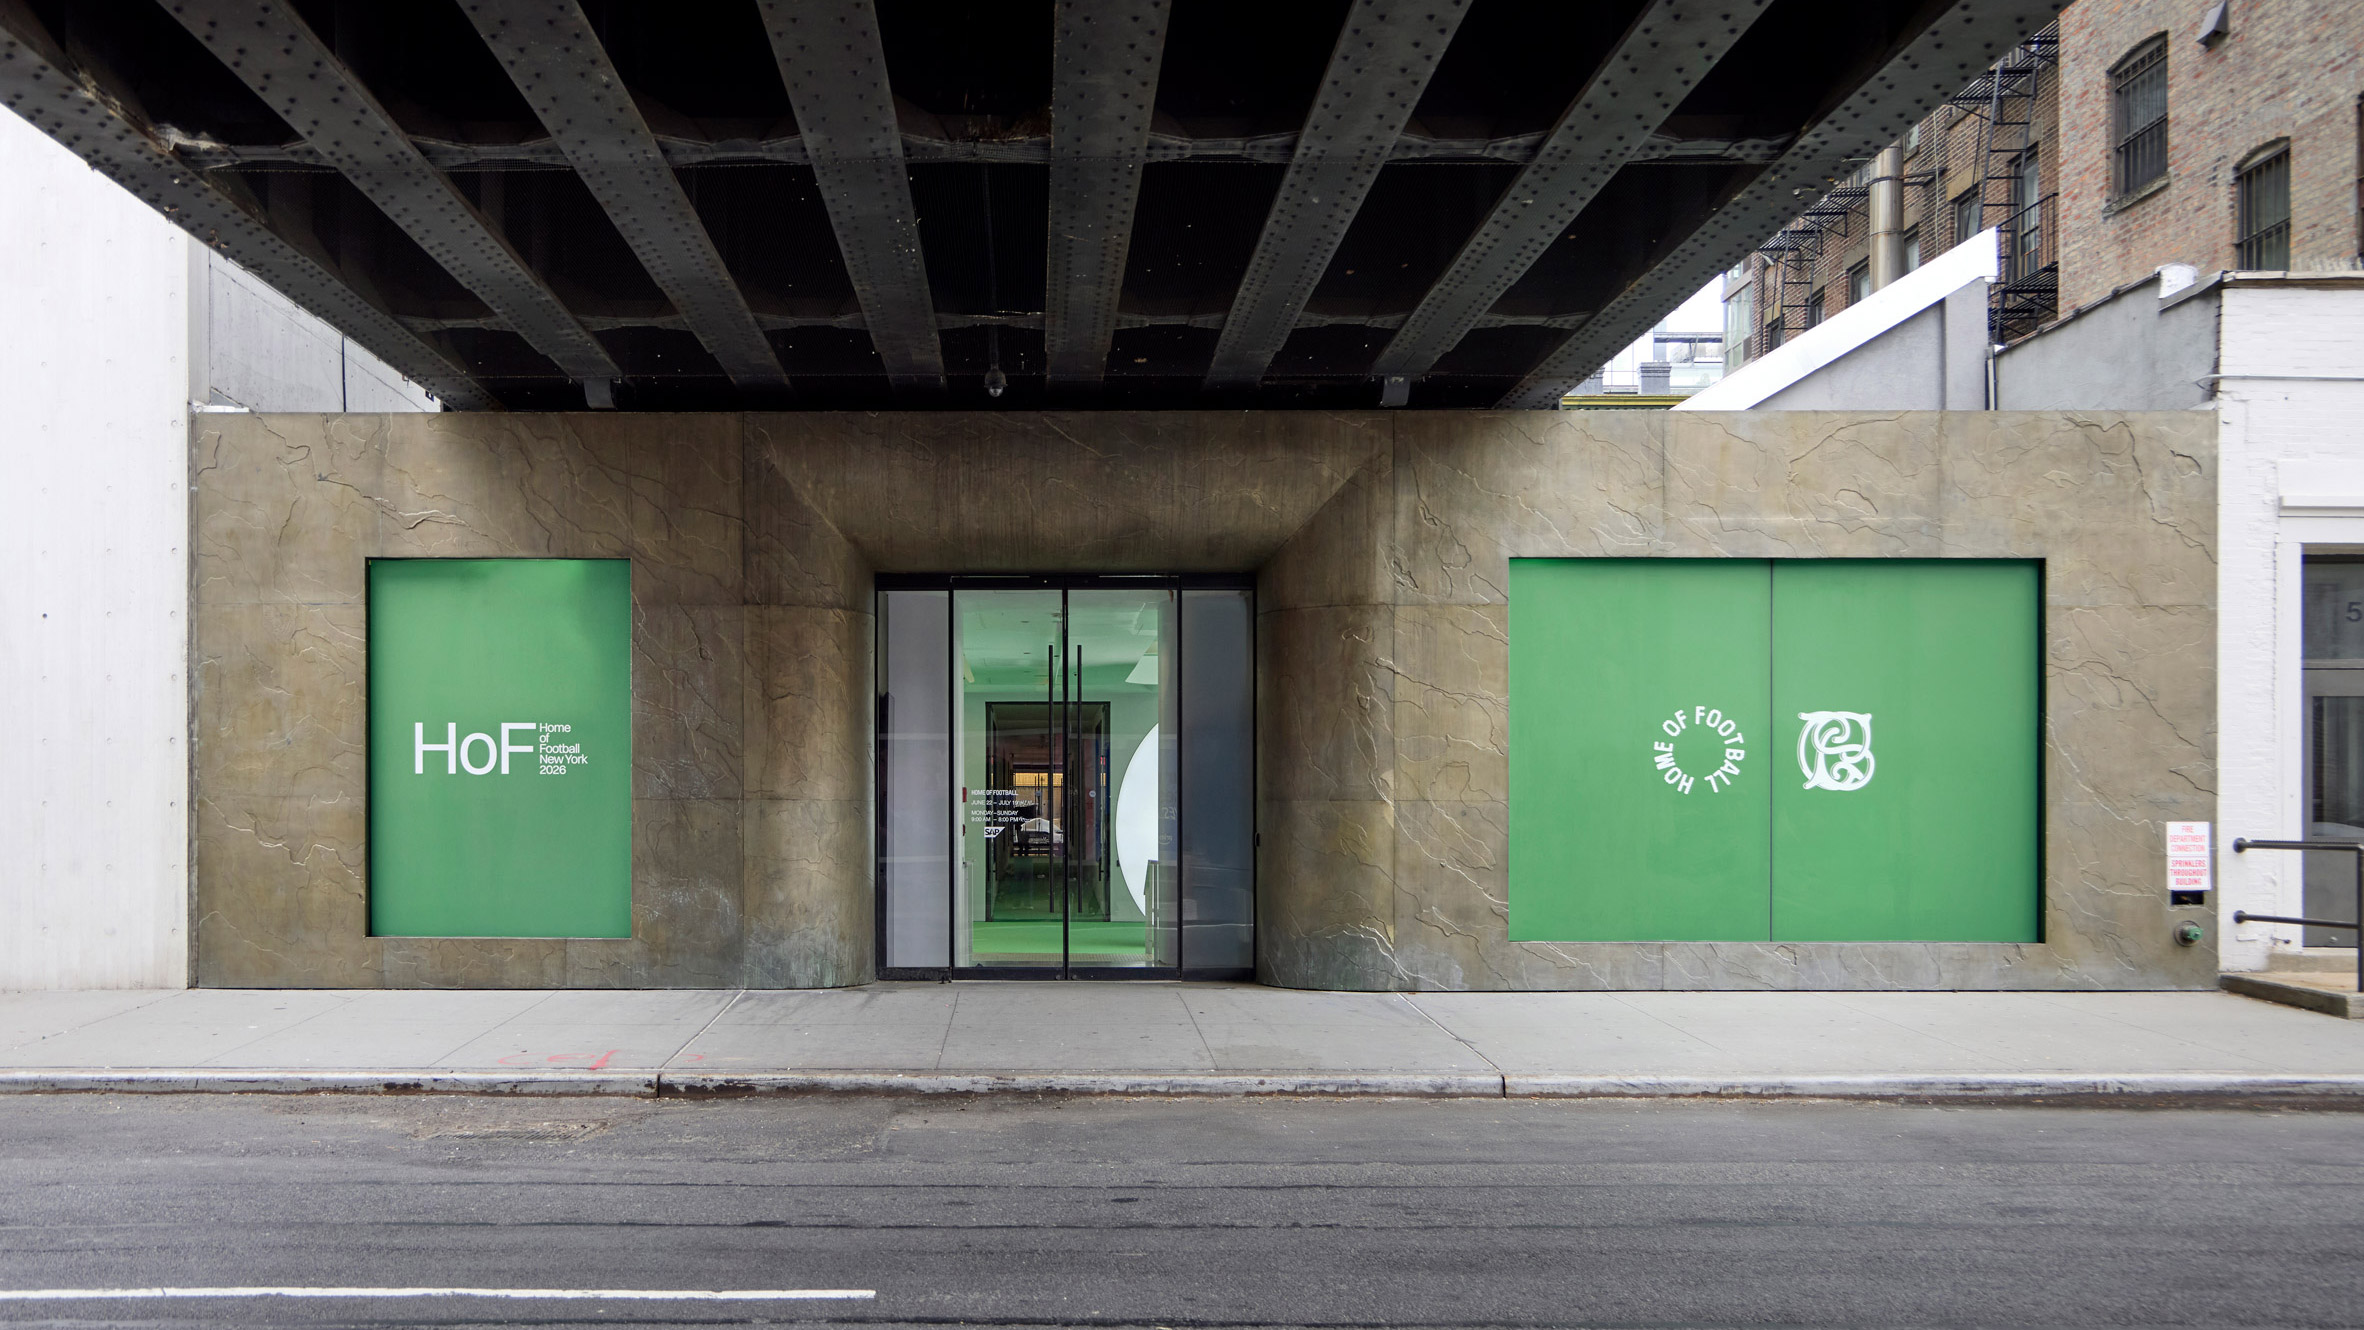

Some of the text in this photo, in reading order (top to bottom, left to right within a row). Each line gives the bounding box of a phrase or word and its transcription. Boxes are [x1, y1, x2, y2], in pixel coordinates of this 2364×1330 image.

[539, 722, 571, 733] Home
[1662, 709, 1688, 737] OF
[539, 732, 550, 744] of
[415, 722, 536, 775] HoF
[539, 743, 580, 754] Football
[1695, 705, 1746, 794] FOOTBALL
[539, 754, 588, 765] New York
[539, 765, 567, 775] 2026
[1653, 741, 1695, 795] HOME
[2181, 825, 2194, 833] FIRE
[2169, 835, 2206, 843] DEPARTMENT
[2171, 844, 2205, 852] CONNECTION
[2171, 859, 2206, 868] SPRINKLERS
[2170, 868, 2207, 877] THROUGHOUT
